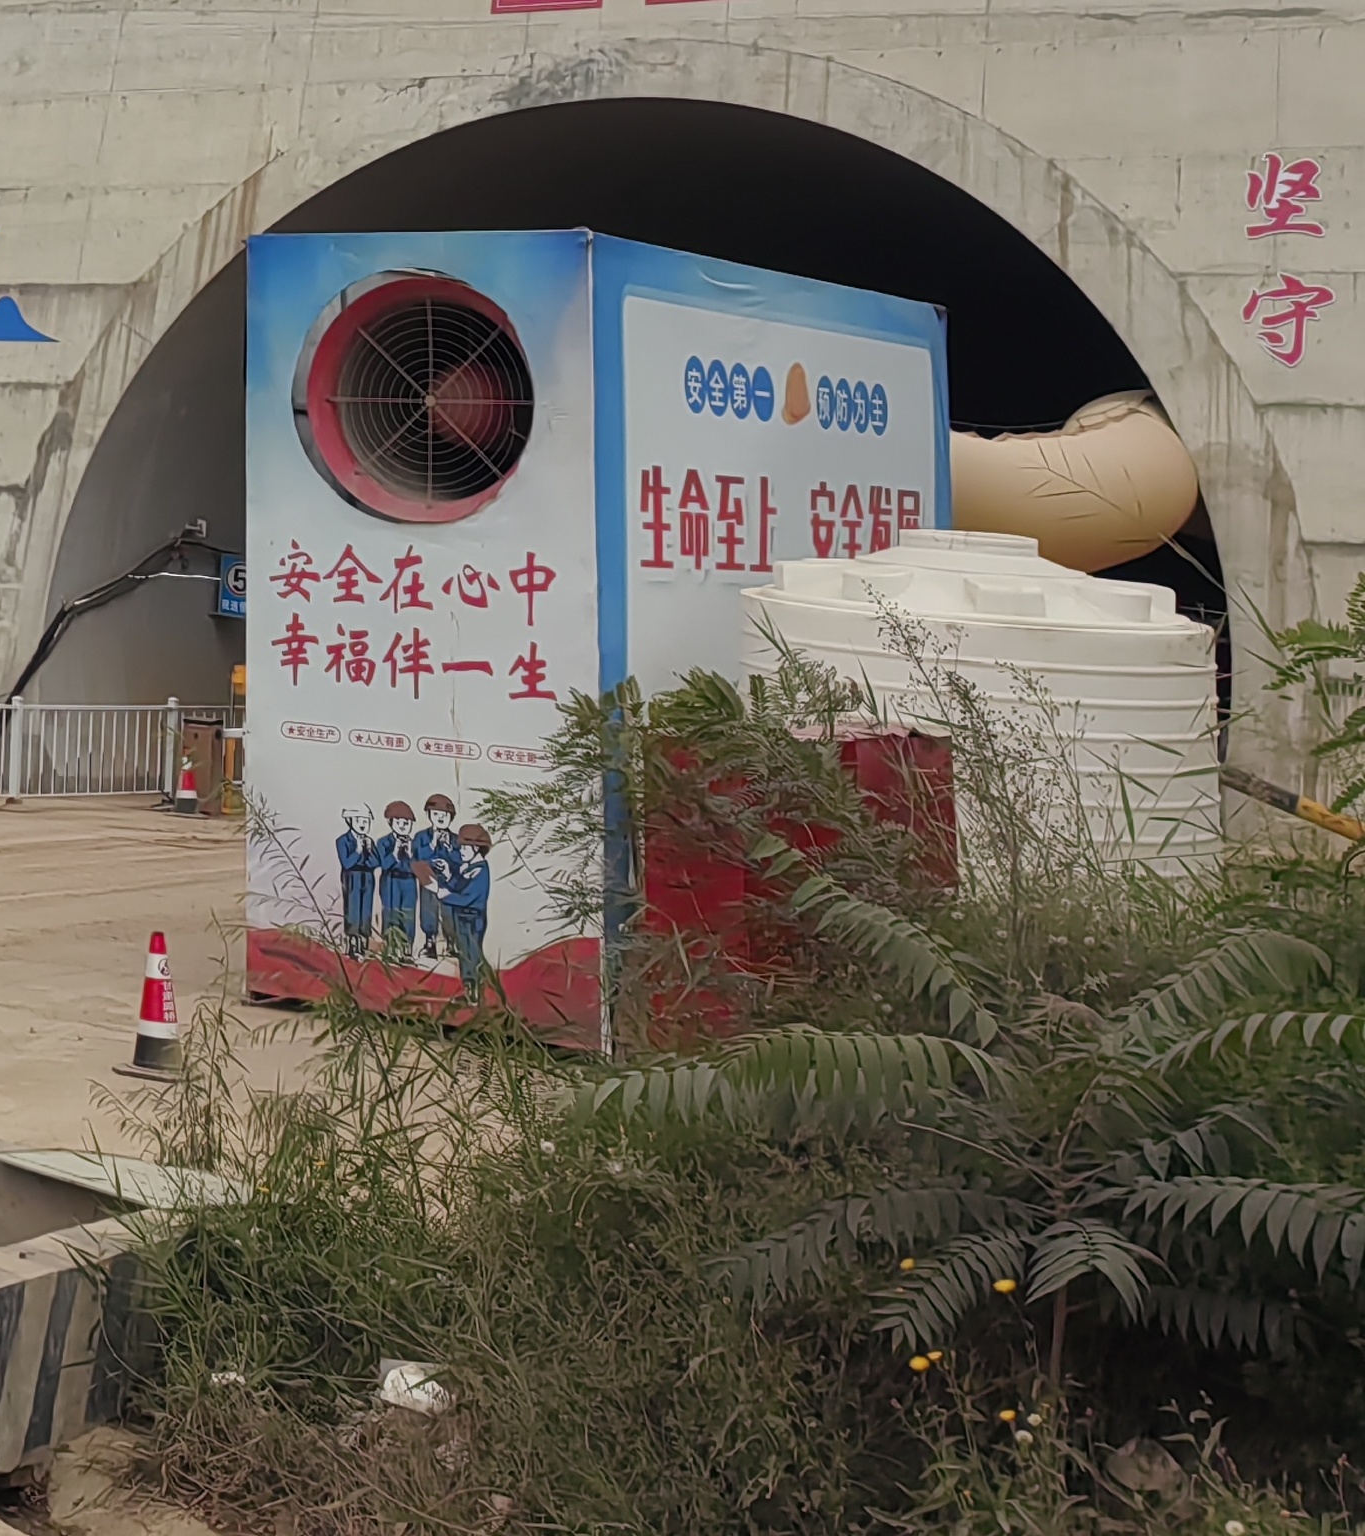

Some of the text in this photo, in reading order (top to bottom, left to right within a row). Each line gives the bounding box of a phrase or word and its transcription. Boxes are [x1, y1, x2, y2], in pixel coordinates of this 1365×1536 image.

[1242, 151, 1336, 368] 坚守
[687, 368, 884, 428] 安全第一 预防为主
[640, 465, 777, 573] 生命至上
[269, 539, 558, 627] 安全在心中
[270, 612, 558, 703] 幸福伴一生
